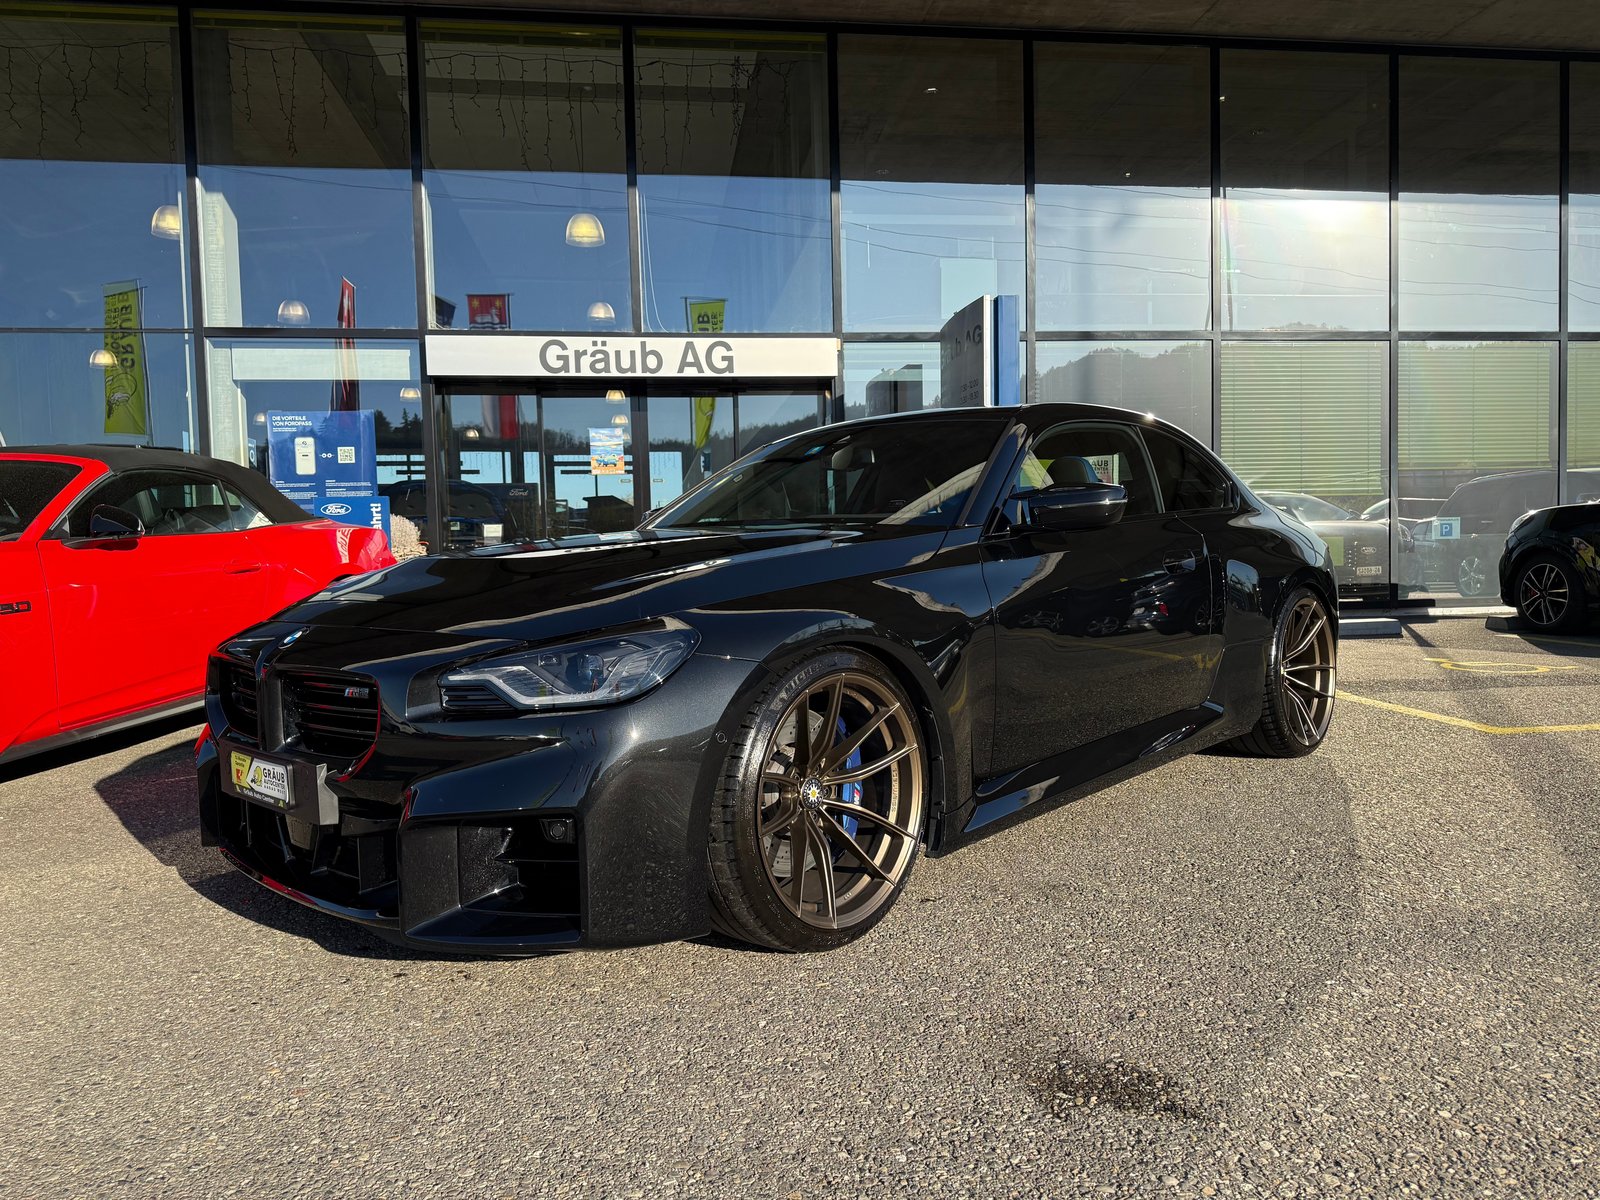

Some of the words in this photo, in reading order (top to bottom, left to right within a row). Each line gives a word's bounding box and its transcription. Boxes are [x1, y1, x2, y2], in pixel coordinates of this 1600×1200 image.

[539, 339, 664, 374] Gräub
[677, 340, 735, 374] AG
[509, 488, 529, 496] Ford
[323, 504, 349, 514] Ford
[262, 767, 285, 783] GRÄUB
